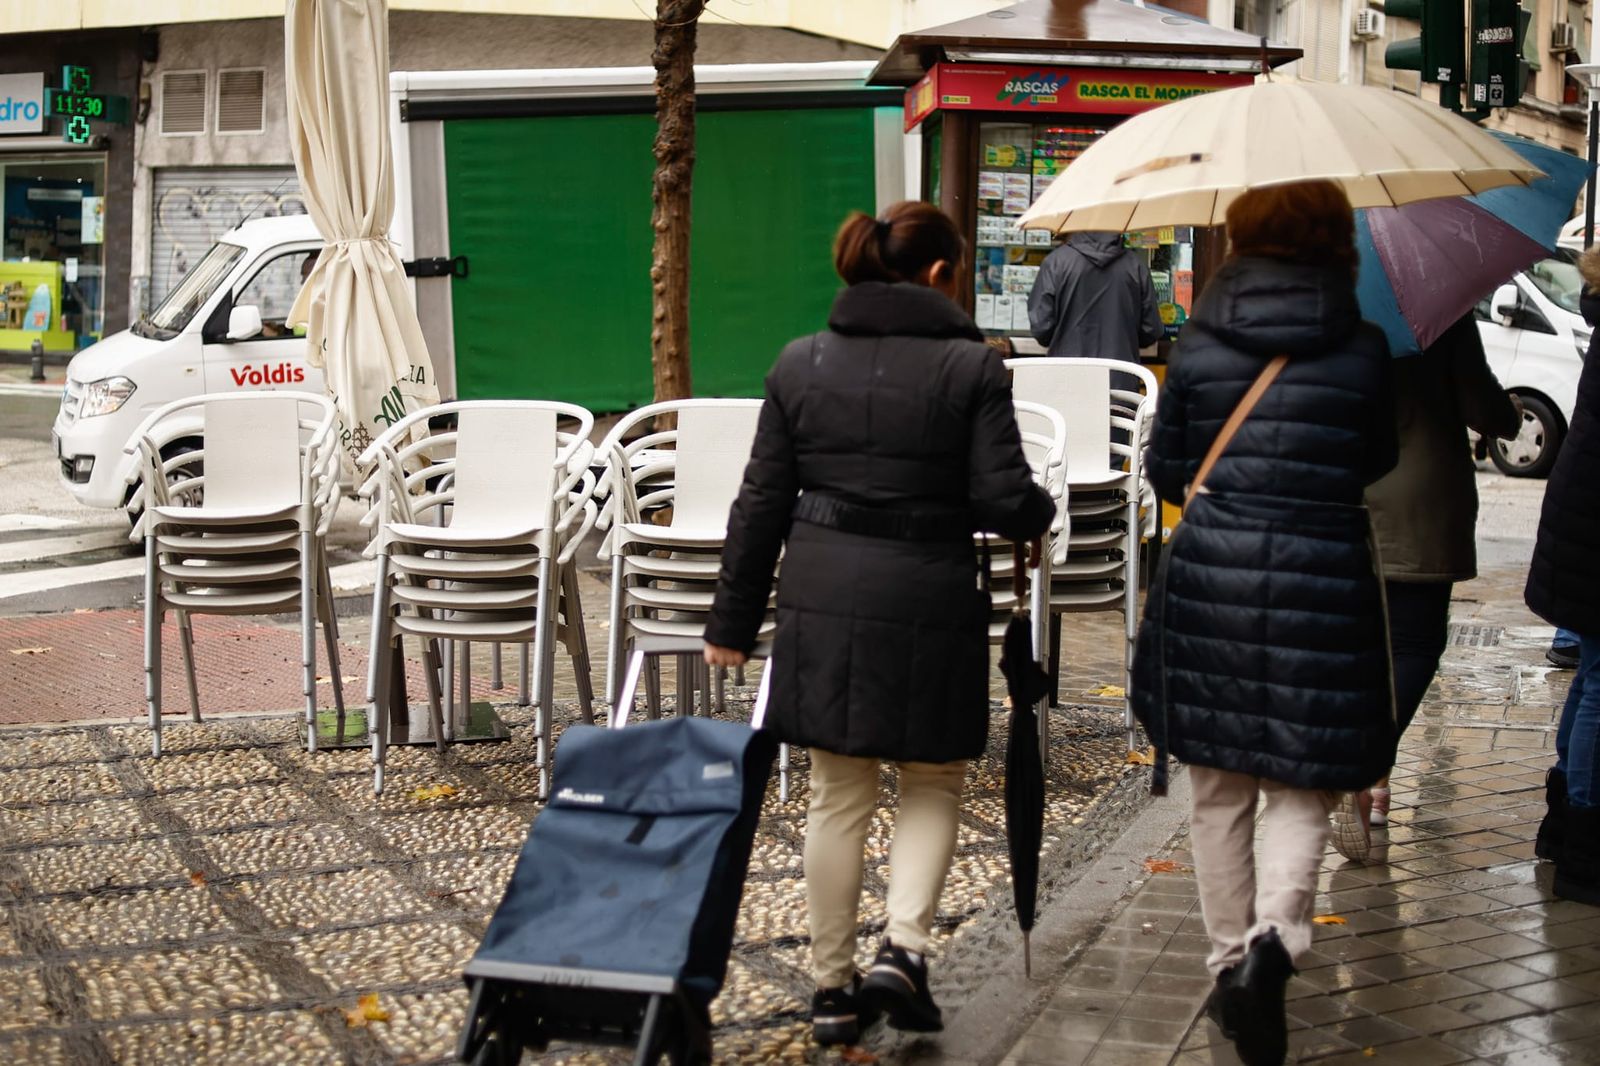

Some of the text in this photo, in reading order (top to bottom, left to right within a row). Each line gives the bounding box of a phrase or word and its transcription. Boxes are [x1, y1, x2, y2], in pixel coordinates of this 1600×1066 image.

[1004, 81, 1059, 94] RASCAS
[1079, 84, 1130, 98] RASCA
[1134, 86, 1151, 99] EL
[0, 96, 39, 121] dro
[56, 95, 103, 116] 11:30
[230, 362, 305, 387] Voldis
